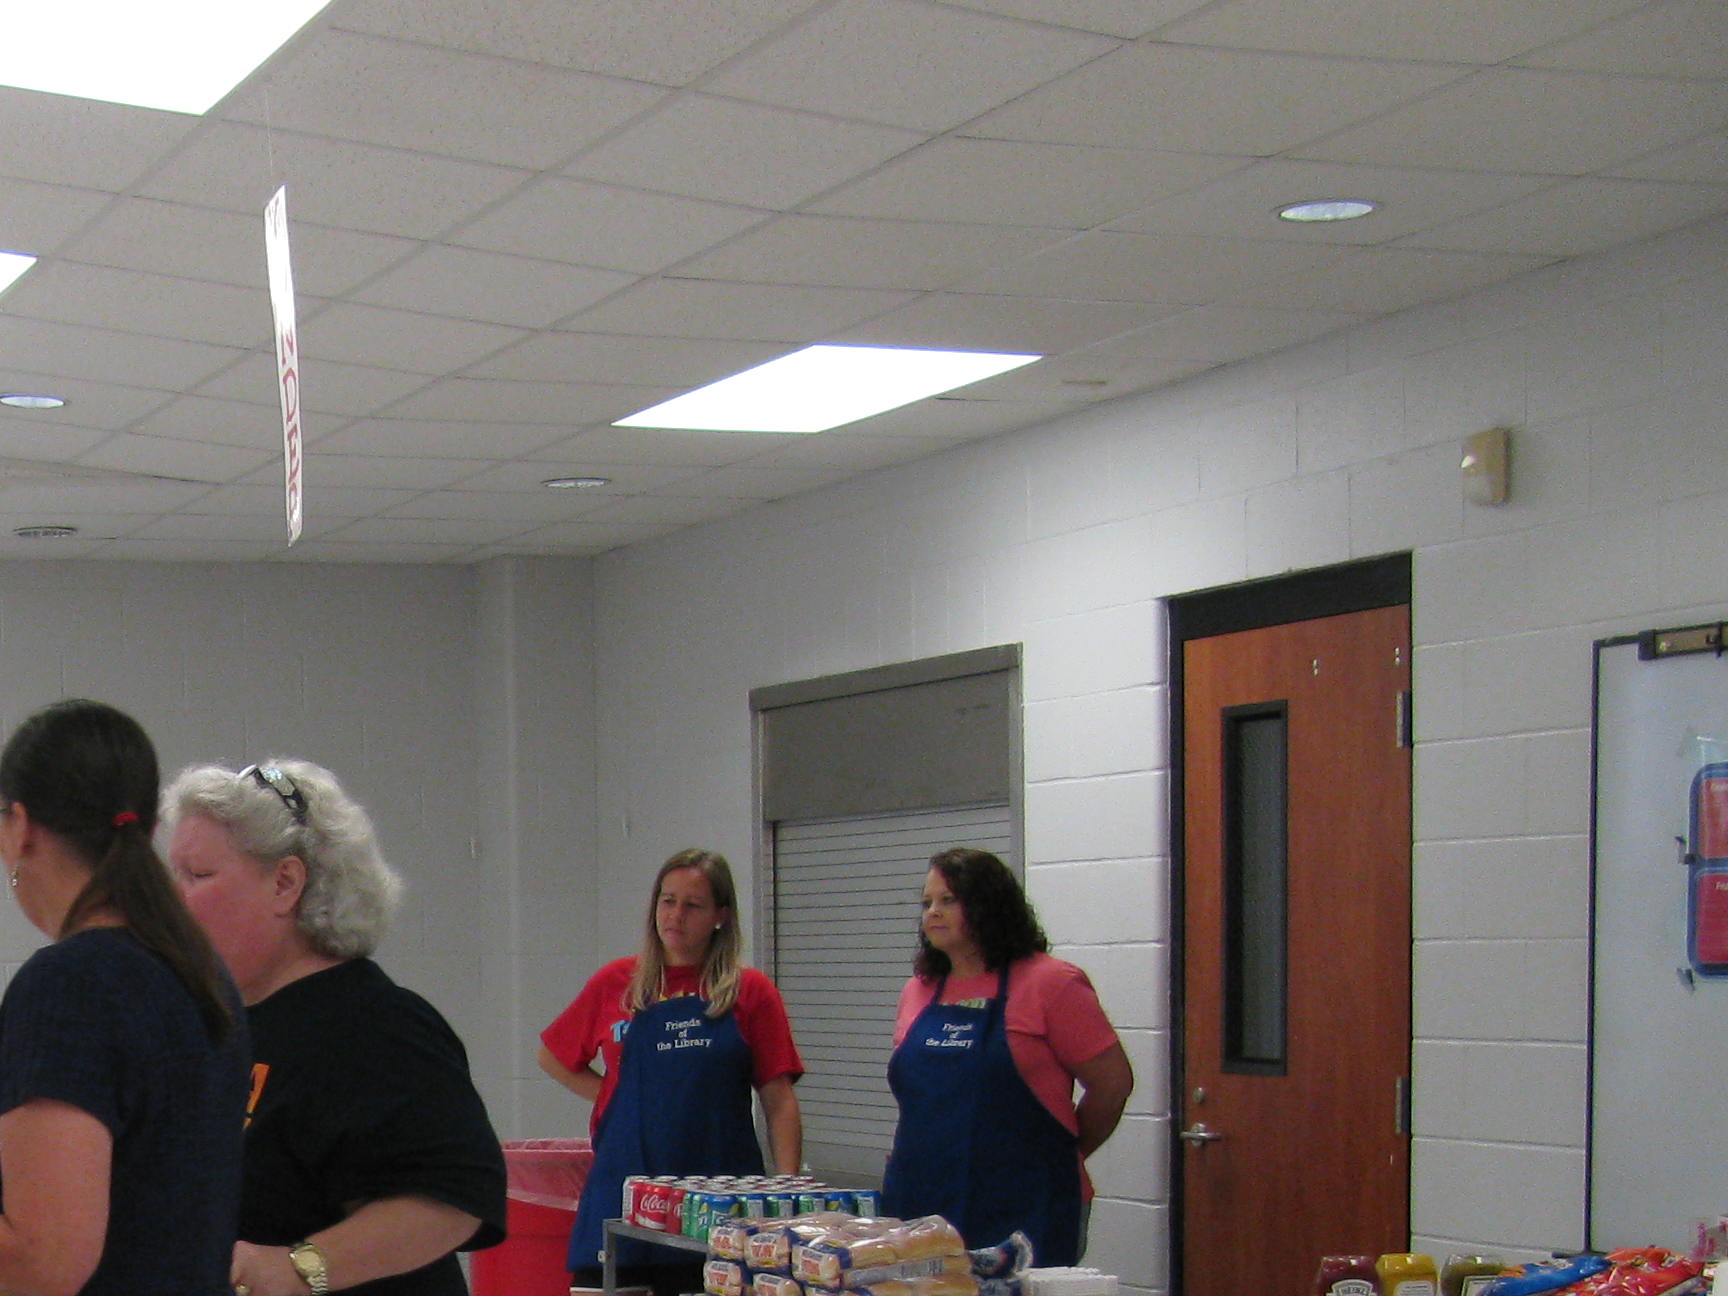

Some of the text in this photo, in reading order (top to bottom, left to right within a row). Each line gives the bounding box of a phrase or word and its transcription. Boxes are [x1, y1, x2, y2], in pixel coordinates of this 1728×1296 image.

[664, 1018, 702, 1032] Friends
[656, 1038, 712, 1051] the Library
